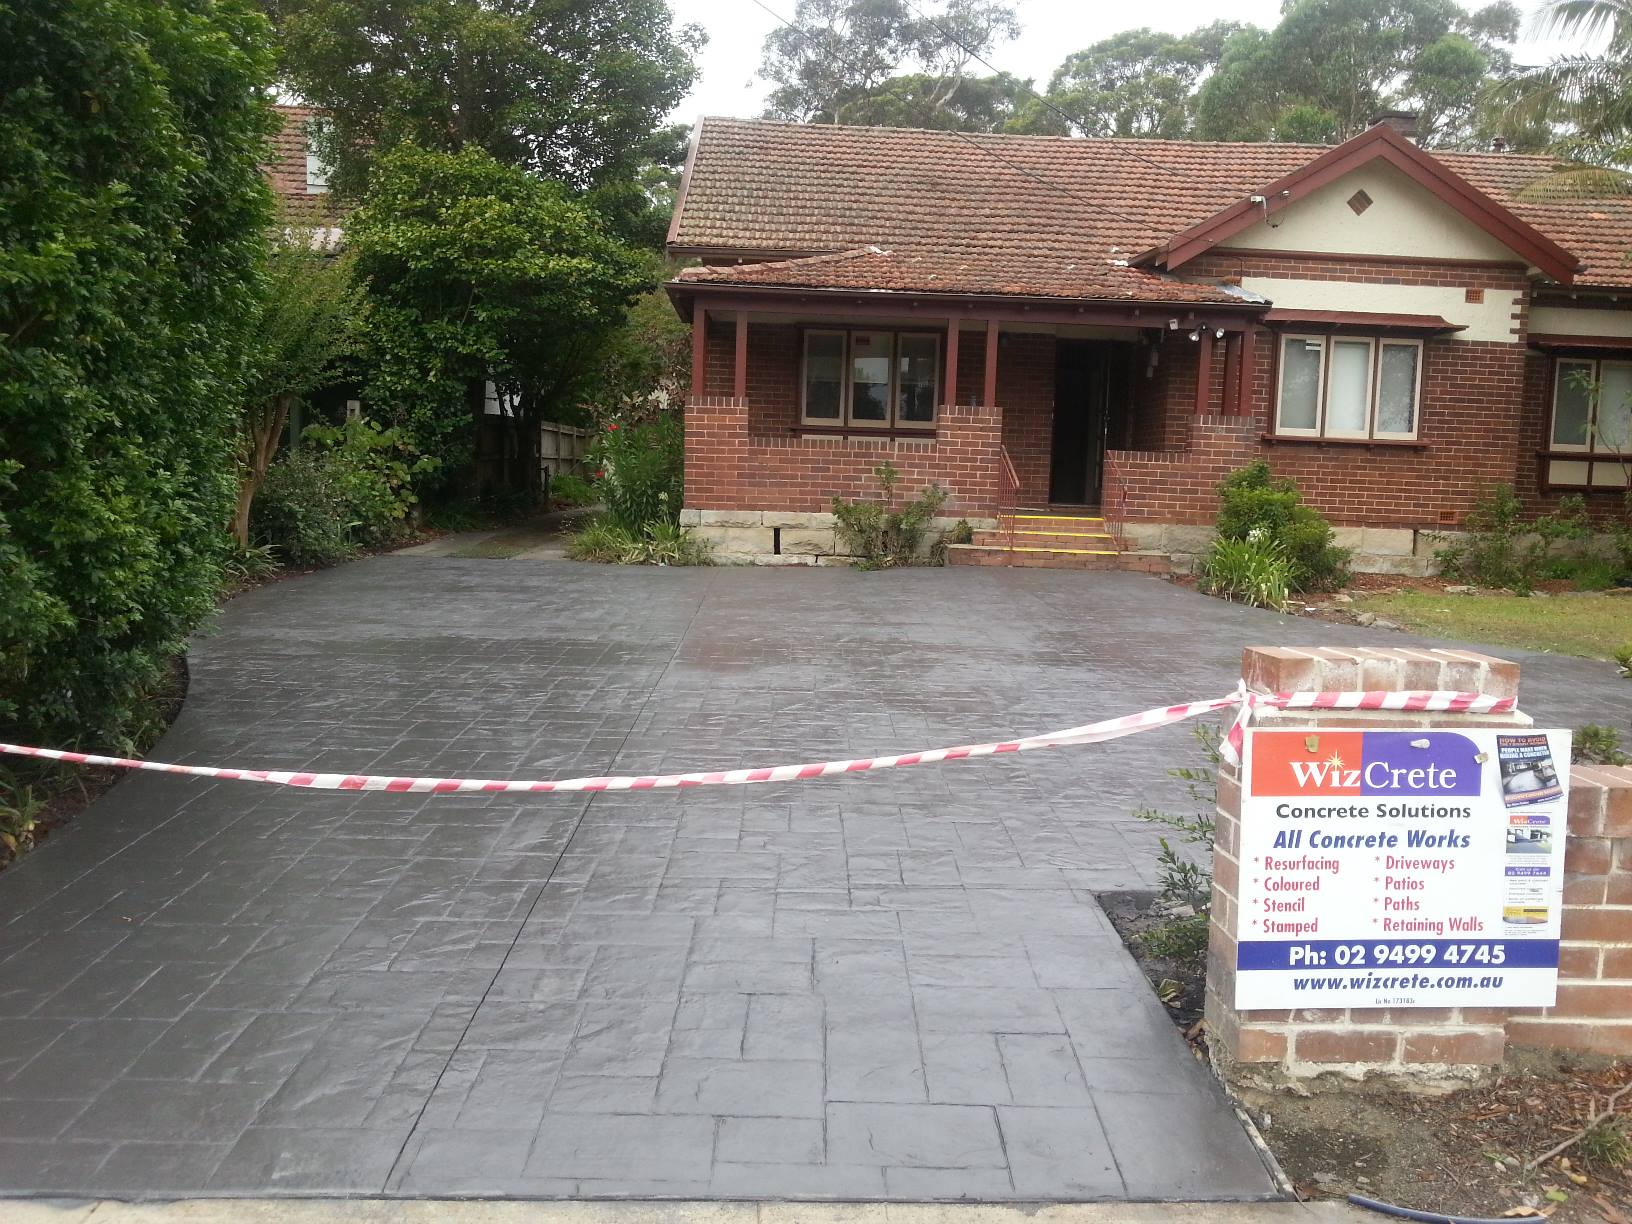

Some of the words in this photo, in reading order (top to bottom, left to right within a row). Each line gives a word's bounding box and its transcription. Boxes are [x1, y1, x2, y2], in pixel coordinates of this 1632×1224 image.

[1289, 754, 1457, 789] WizCrete
[1276, 804, 1369, 818] Concrete
[1376, 803, 1471, 818] Solutions
[1273, 830, 1302, 848] All
[1309, 830, 1398, 848] Concrete
[1407, 829, 1471, 848] Works
[1264, 855, 1340, 873] Resurfacing
[1385, 855, 1455, 873] Driveways
[1264, 877, 1320, 891] Coloured
[1385, 876, 1425, 891] Patios
[1263, 898, 1305, 912] Stencil
[1384, 897, 1420, 911] Paths
[1263, 918, 1318, 936] Stamped
[1383, 918, 1444, 935] Retaining
[1448, 917, 1484, 932] Walls
[1289, 946, 1326, 965] Ph:
[1334, 946, 1366, 965] 02
[1373, 945, 1437, 965] 9499
[1443, 944, 1506, 964] 4745
[1293, 972, 1504, 991] www.wizcrete.com.au
